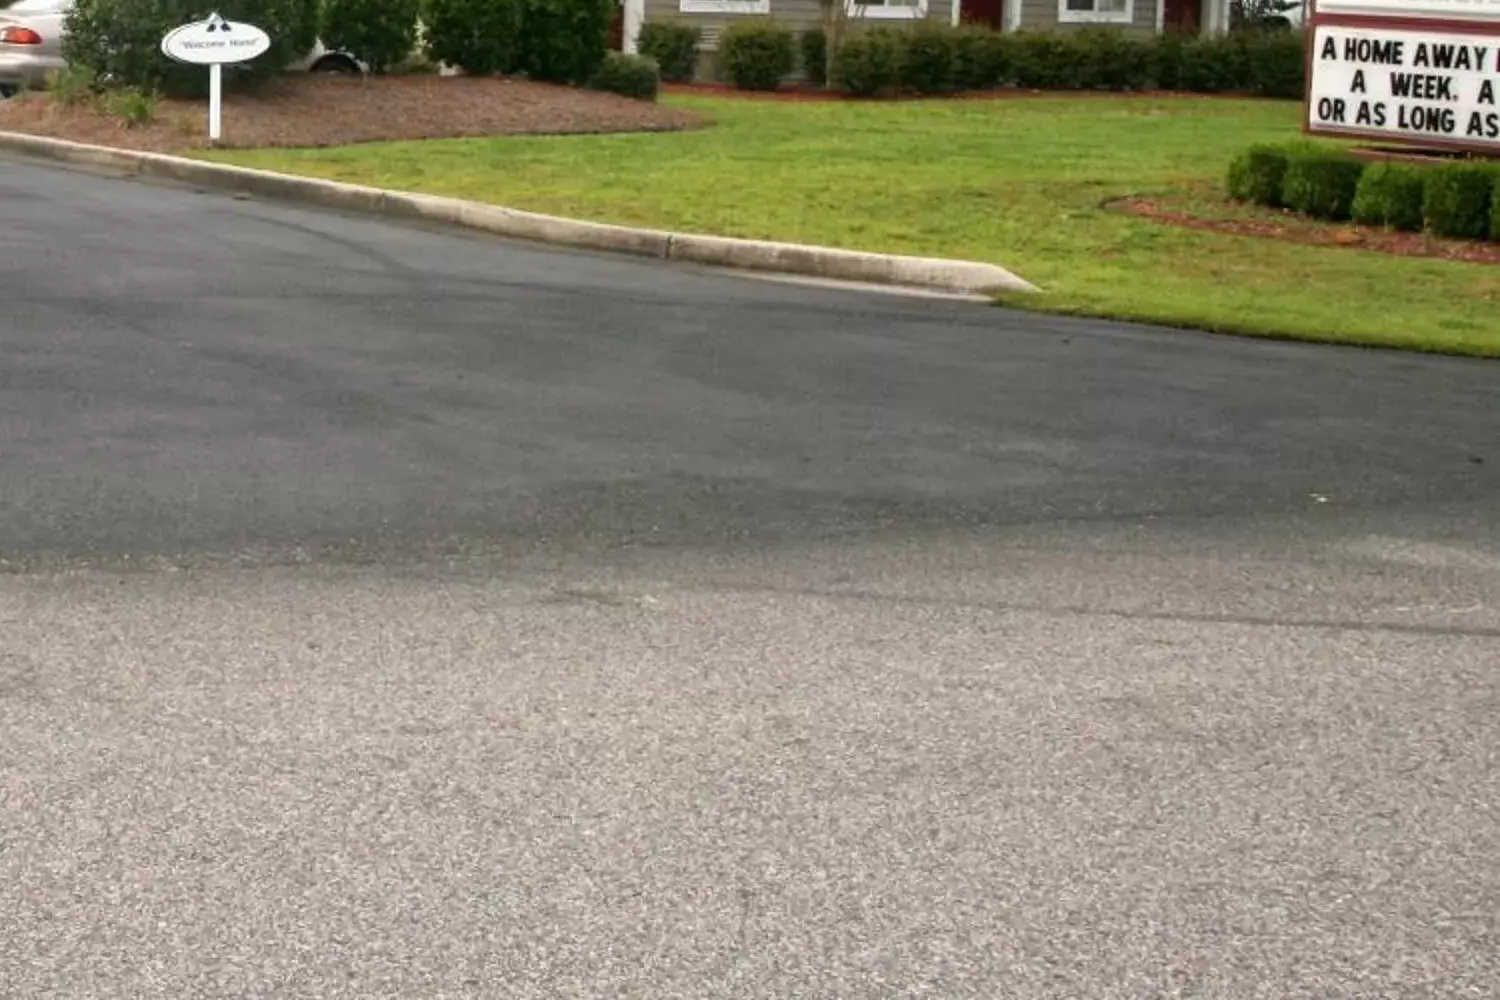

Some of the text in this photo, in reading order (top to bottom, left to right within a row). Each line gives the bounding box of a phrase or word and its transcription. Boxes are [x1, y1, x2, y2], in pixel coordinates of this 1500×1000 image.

[1321, 36, 1337, 60] A
[1344, 37, 1404, 64] HOME
[1413, 42, 1487, 71] AWAY
[1350, 69, 1495, 105] A WEEK. A
[1318, 97, 1499, 138] OR AS LONG AS
